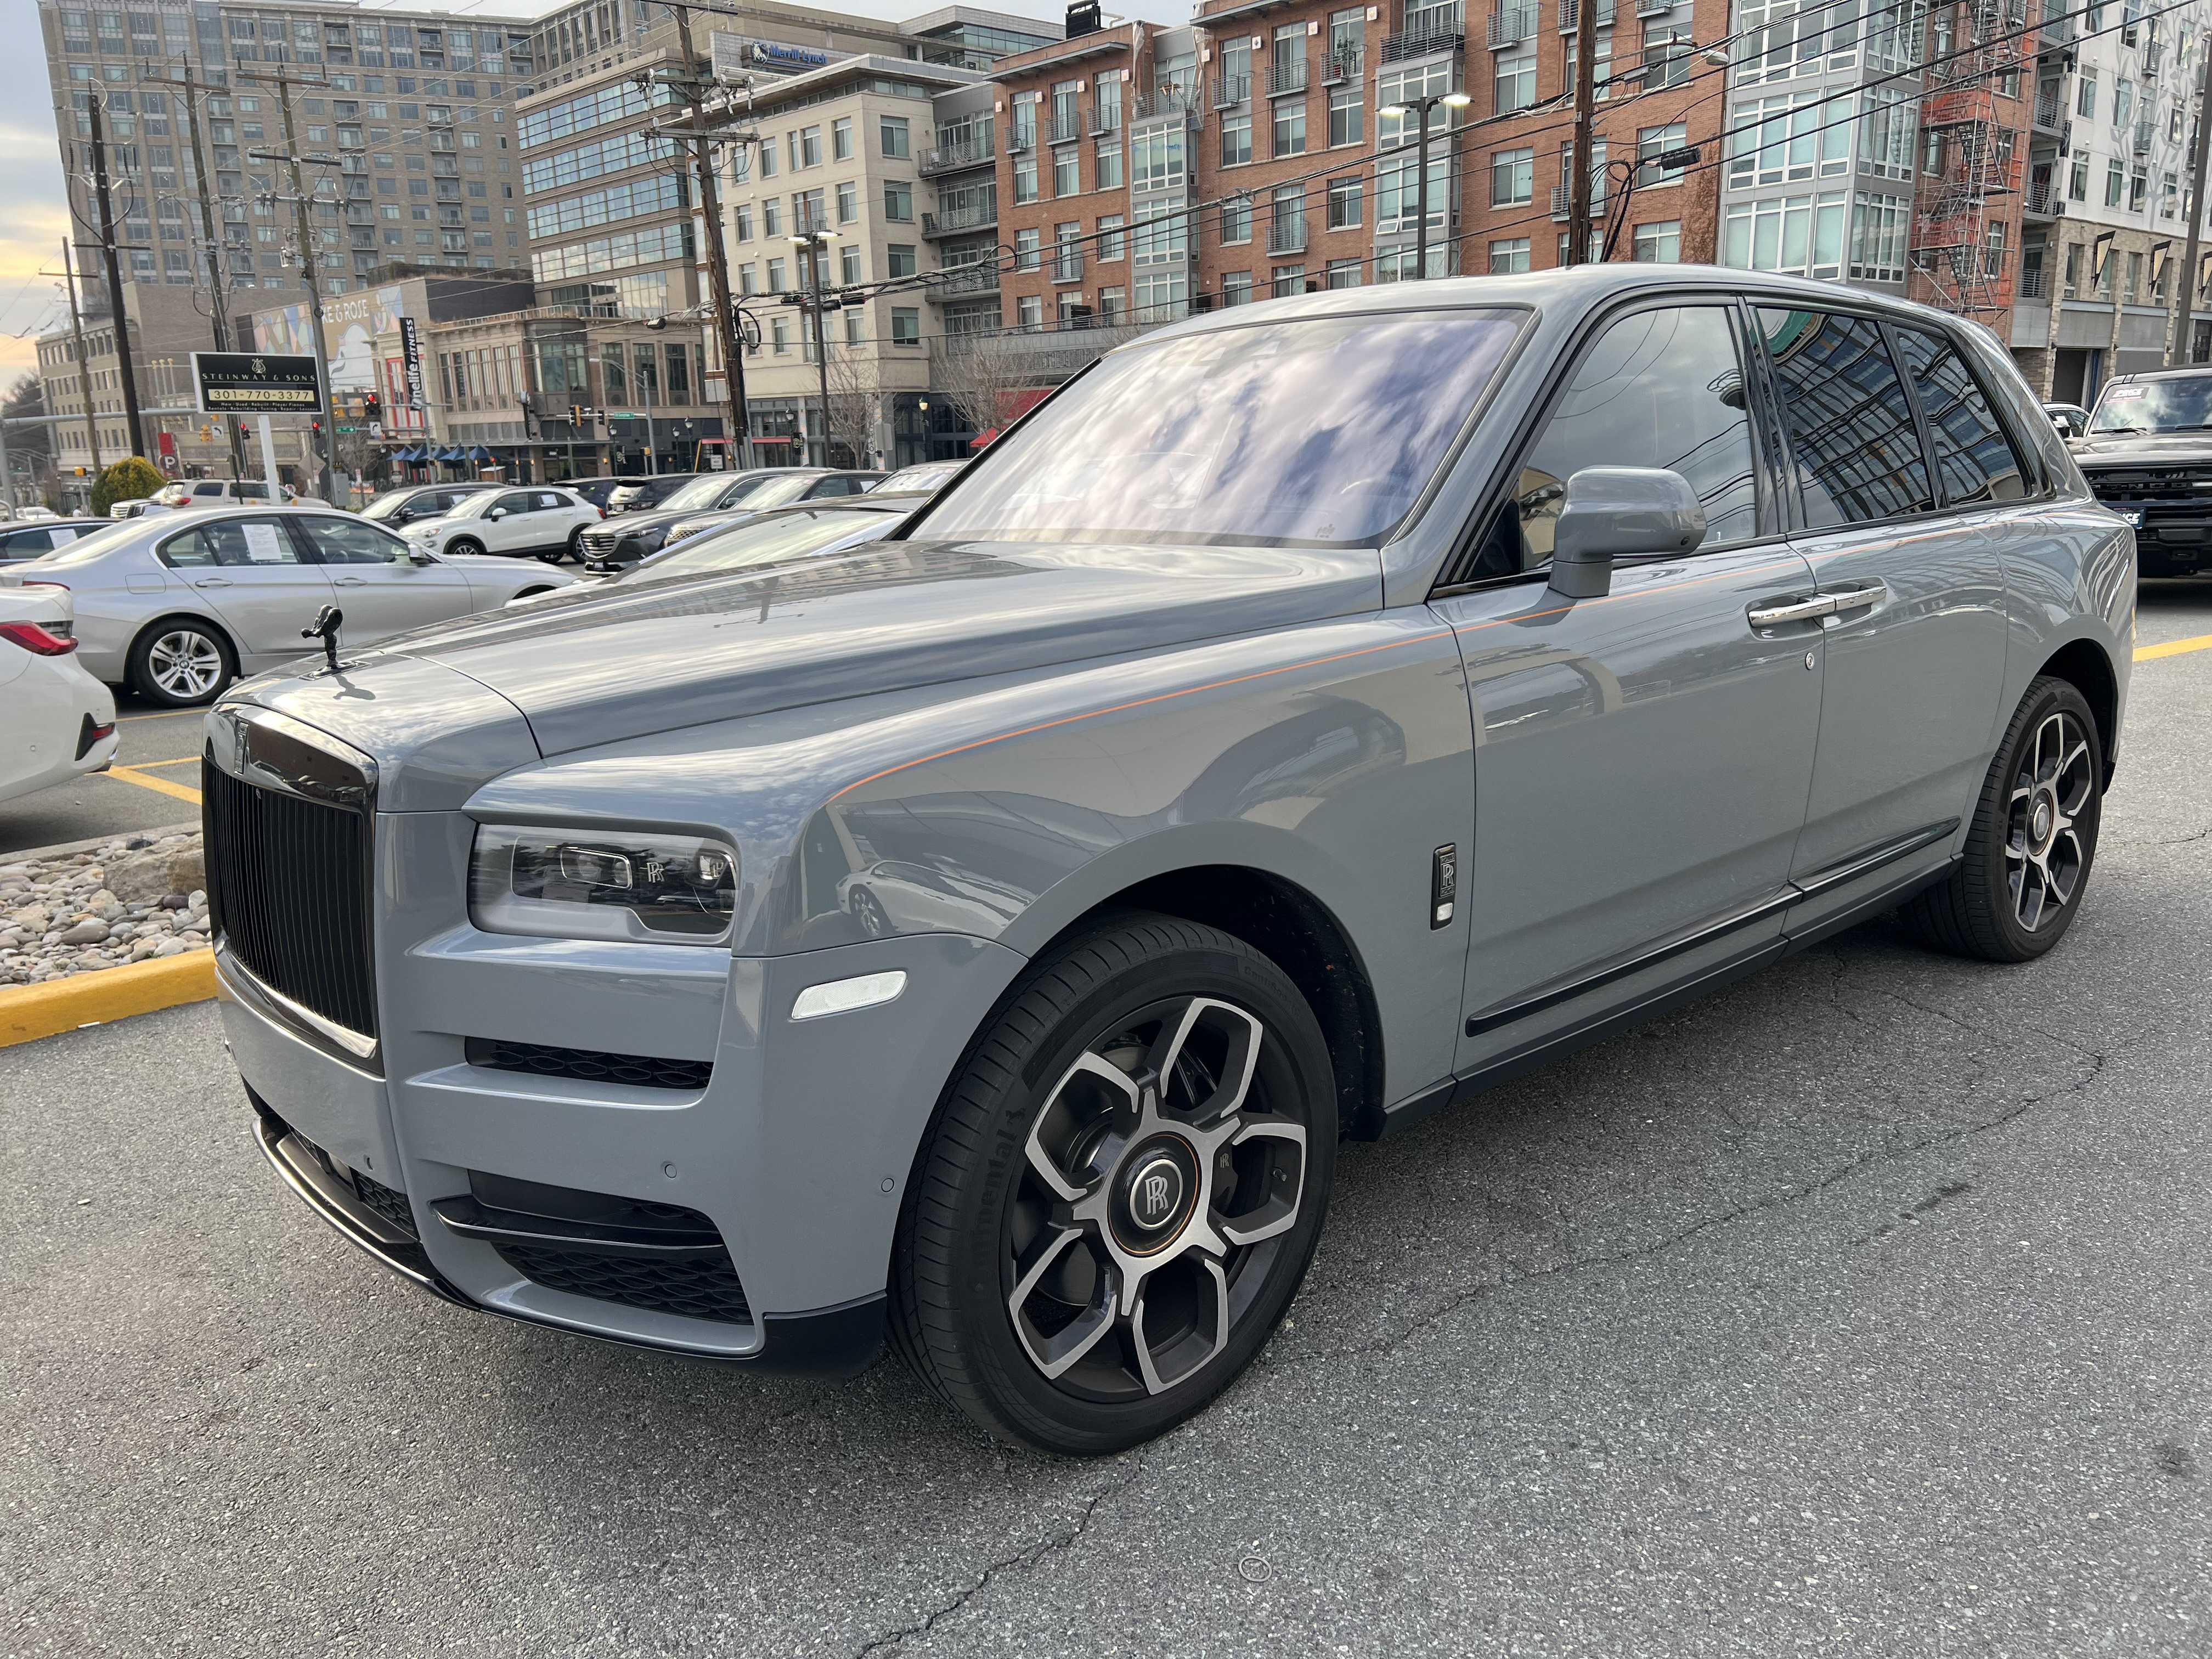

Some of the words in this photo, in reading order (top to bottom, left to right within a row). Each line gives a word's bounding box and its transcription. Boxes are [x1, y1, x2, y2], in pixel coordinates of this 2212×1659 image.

[770, 45, 800, 60] Merrill
[802, 50, 828, 64] Lynch
[321, 304, 334, 325] KE
[335, 307, 343, 323] &
[343, 299, 370, 321] ROSE
[406, 319, 417, 362] FITNESS
[202, 373, 267, 381] STEINWAY
[214, 390, 309, 400] 301-770-3377
[164, 456, 176, 469] P
[2119, 513, 2141, 521] ICE
[647, 862, 665, 883] RR
[1442, 864, 1454, 887] RR
[1145, 1176, 1169, 1215] RR
[969, 1128, 1017, 1297] ntinental
